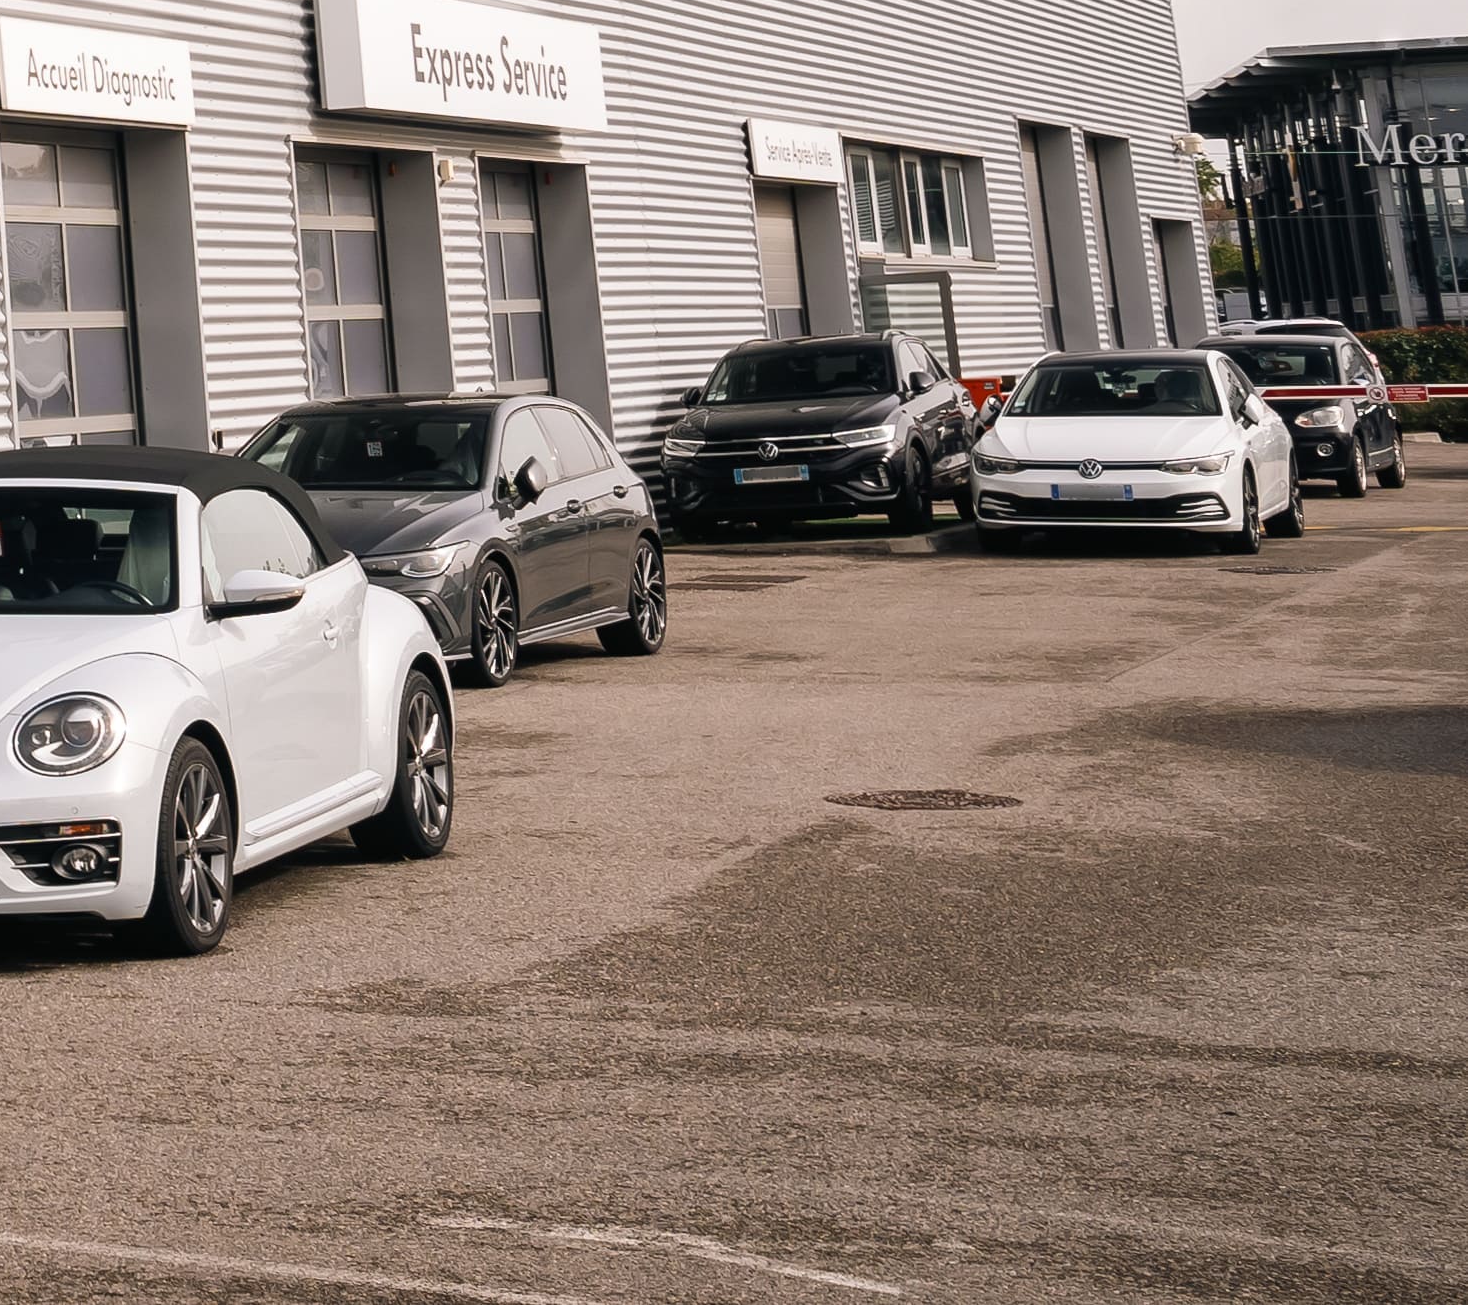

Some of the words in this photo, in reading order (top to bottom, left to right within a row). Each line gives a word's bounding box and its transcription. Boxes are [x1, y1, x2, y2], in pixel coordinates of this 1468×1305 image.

[27, 47, 88, 92] Accueil
[92, 55, 176, 107] Diagnostic
[410, 22, 494, 102] Express
[499, 35, 567, 101] Service
[765, 135, 791, 163] Service
